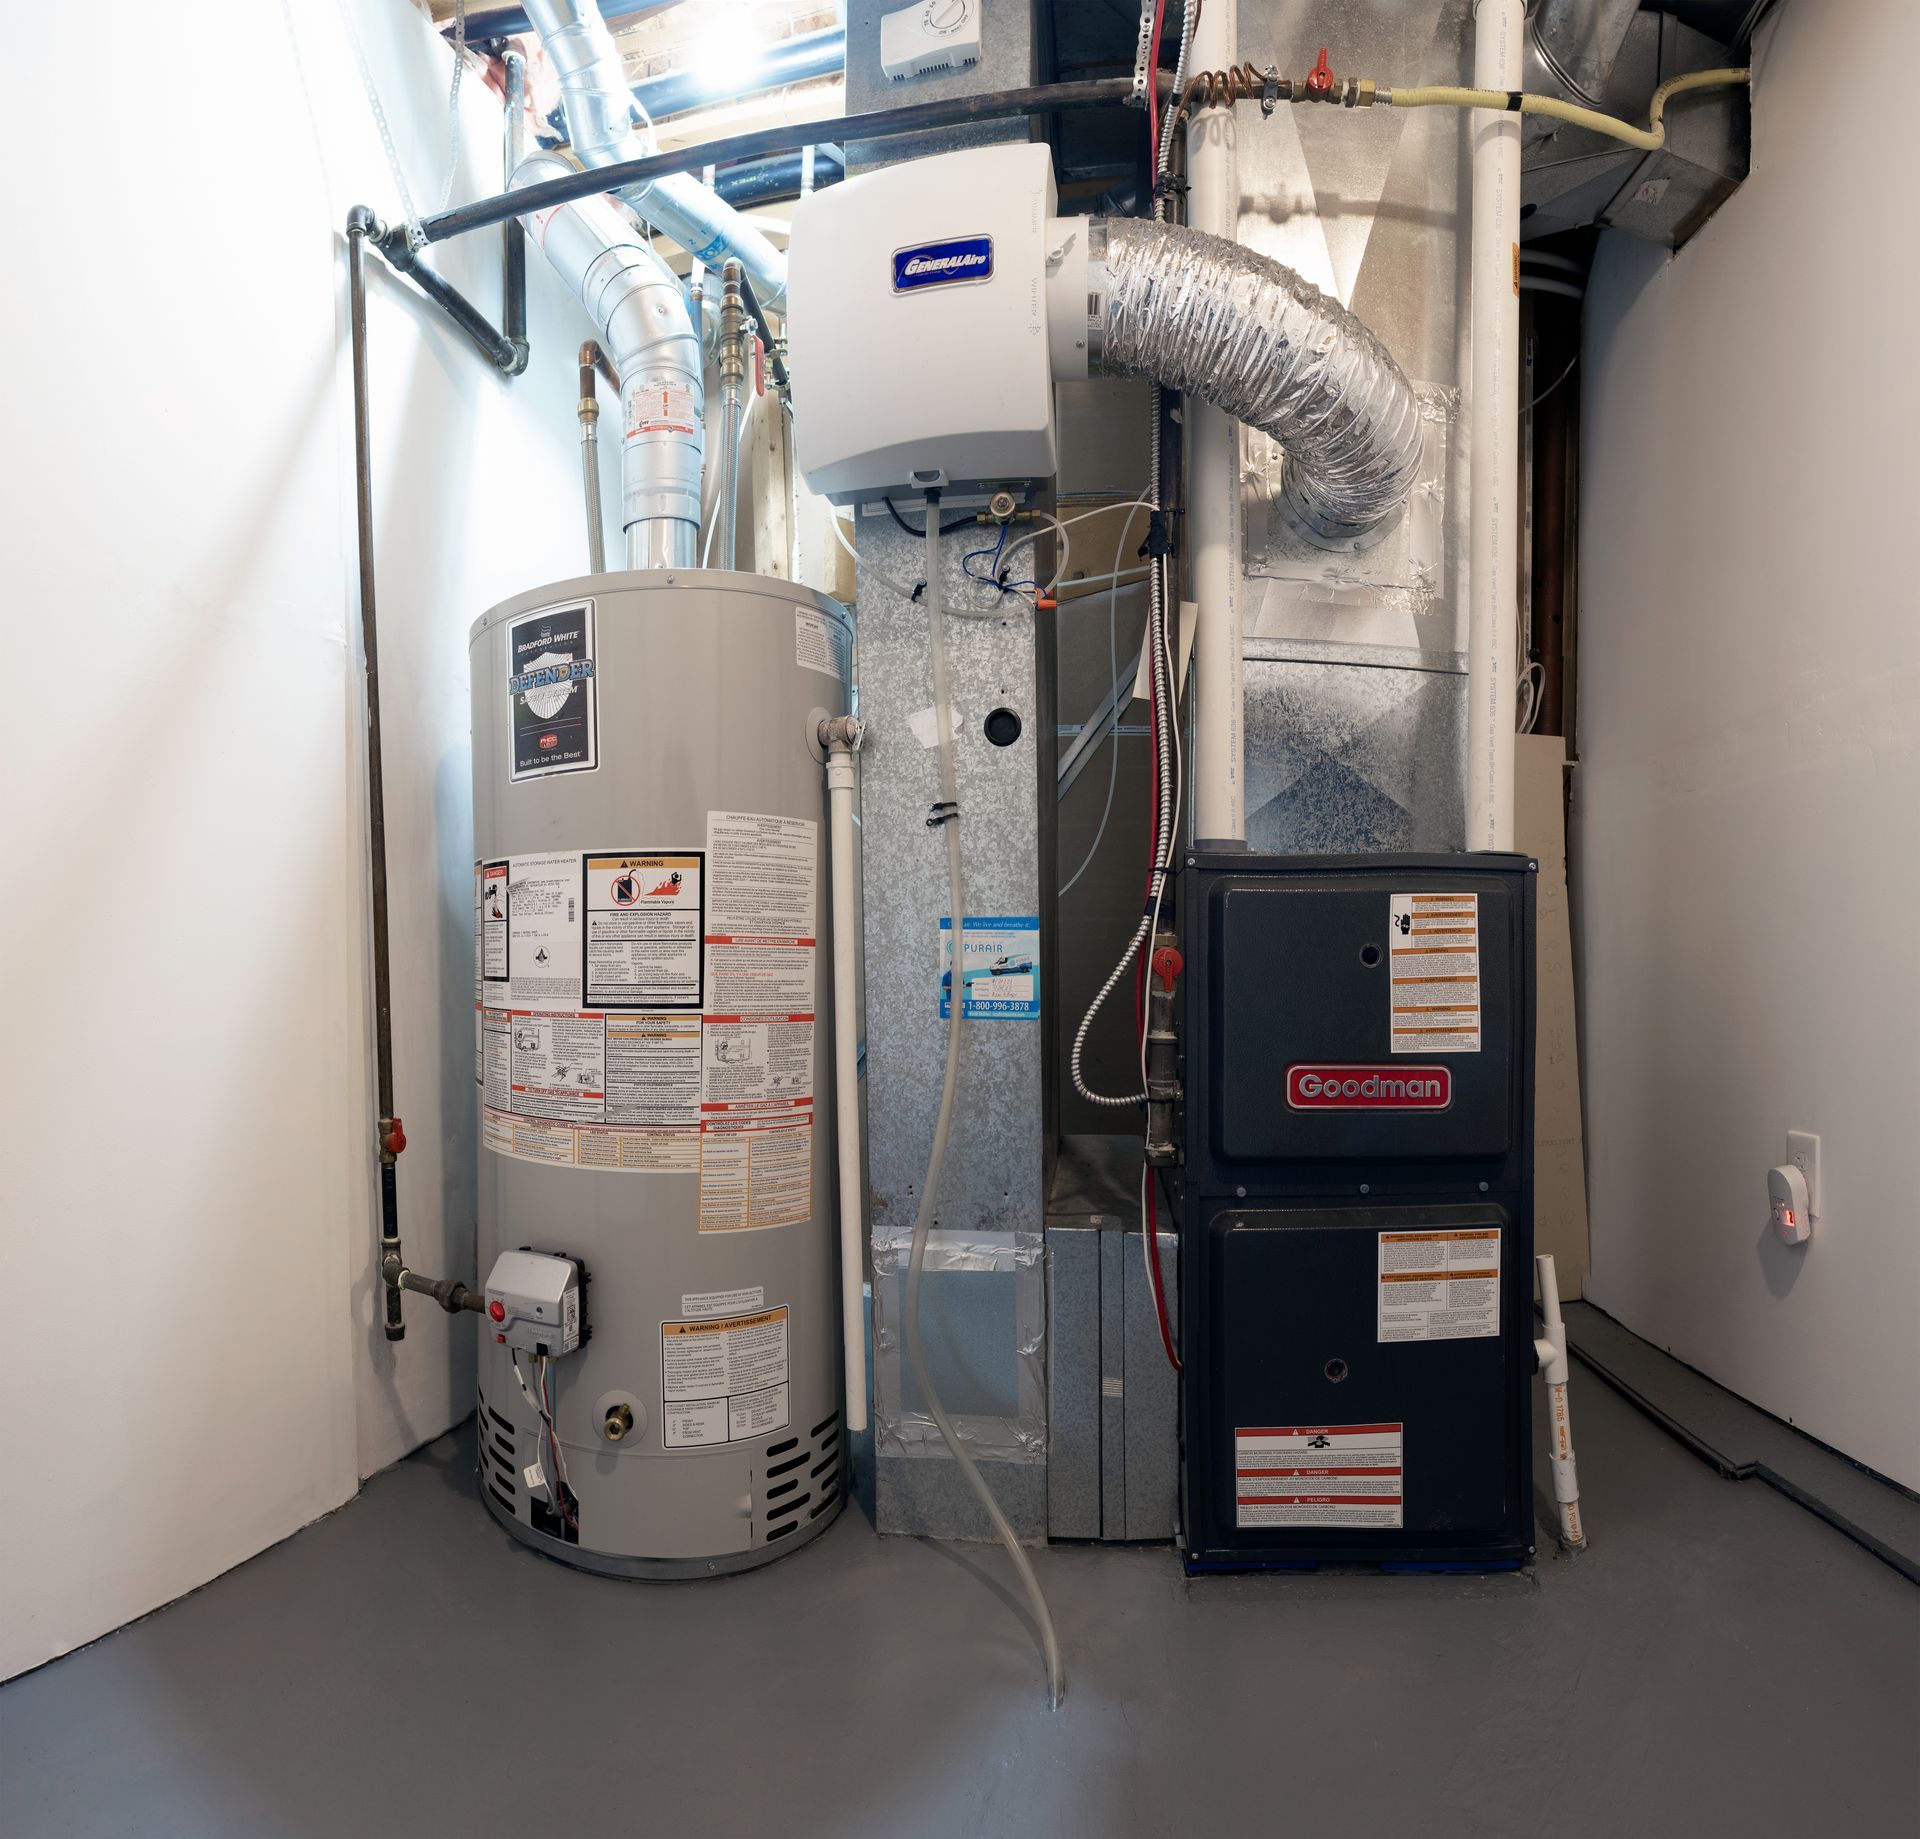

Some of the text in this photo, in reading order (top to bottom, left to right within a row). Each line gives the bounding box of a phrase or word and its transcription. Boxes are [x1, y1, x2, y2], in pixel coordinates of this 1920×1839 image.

[904, 254, 987, 276] GENERALAire
[518, 636, 552, 653] BRADFORD
[554, 631, 580, 643] WHITE
[509, 659, 594, 696] DEFENDER
[964, 944, 1003, 952] PURAIR
[969, 1001, 1029, 1011] 1-800-996-3878
[1299, 1074, 1440, 1098] Goodman
[689, 1324, 720, 1332] WARNING
[725, 1315, 771, 1328] AVERTISSEMENT
[1556, 1405, 1565, 1421] 1785
